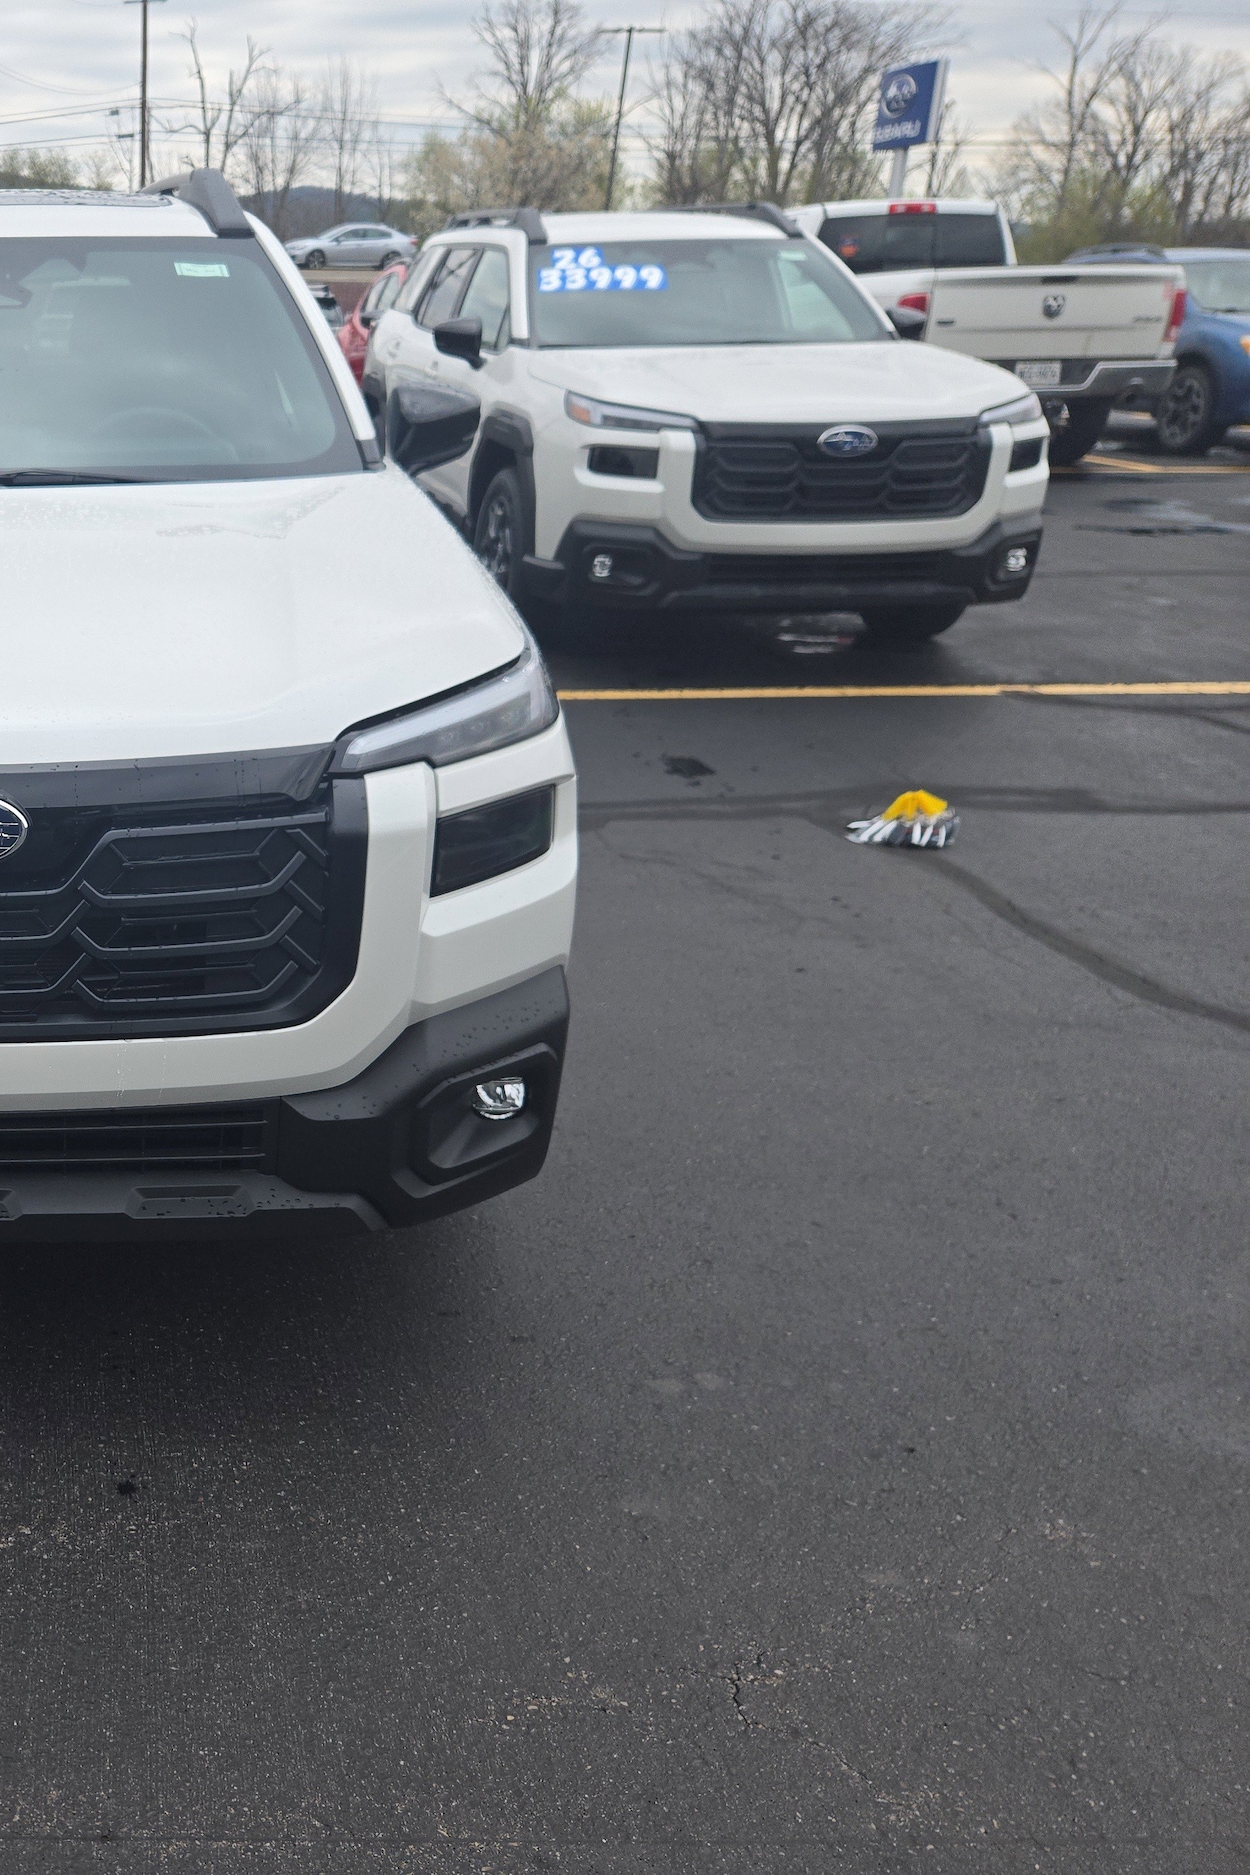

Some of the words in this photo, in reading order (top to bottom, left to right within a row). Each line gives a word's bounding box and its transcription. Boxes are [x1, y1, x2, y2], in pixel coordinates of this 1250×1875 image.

[873, 119, 922, 144] UBARU
[553, 246, 602, 269] 26
[539, 264, 664, 291] 33999
